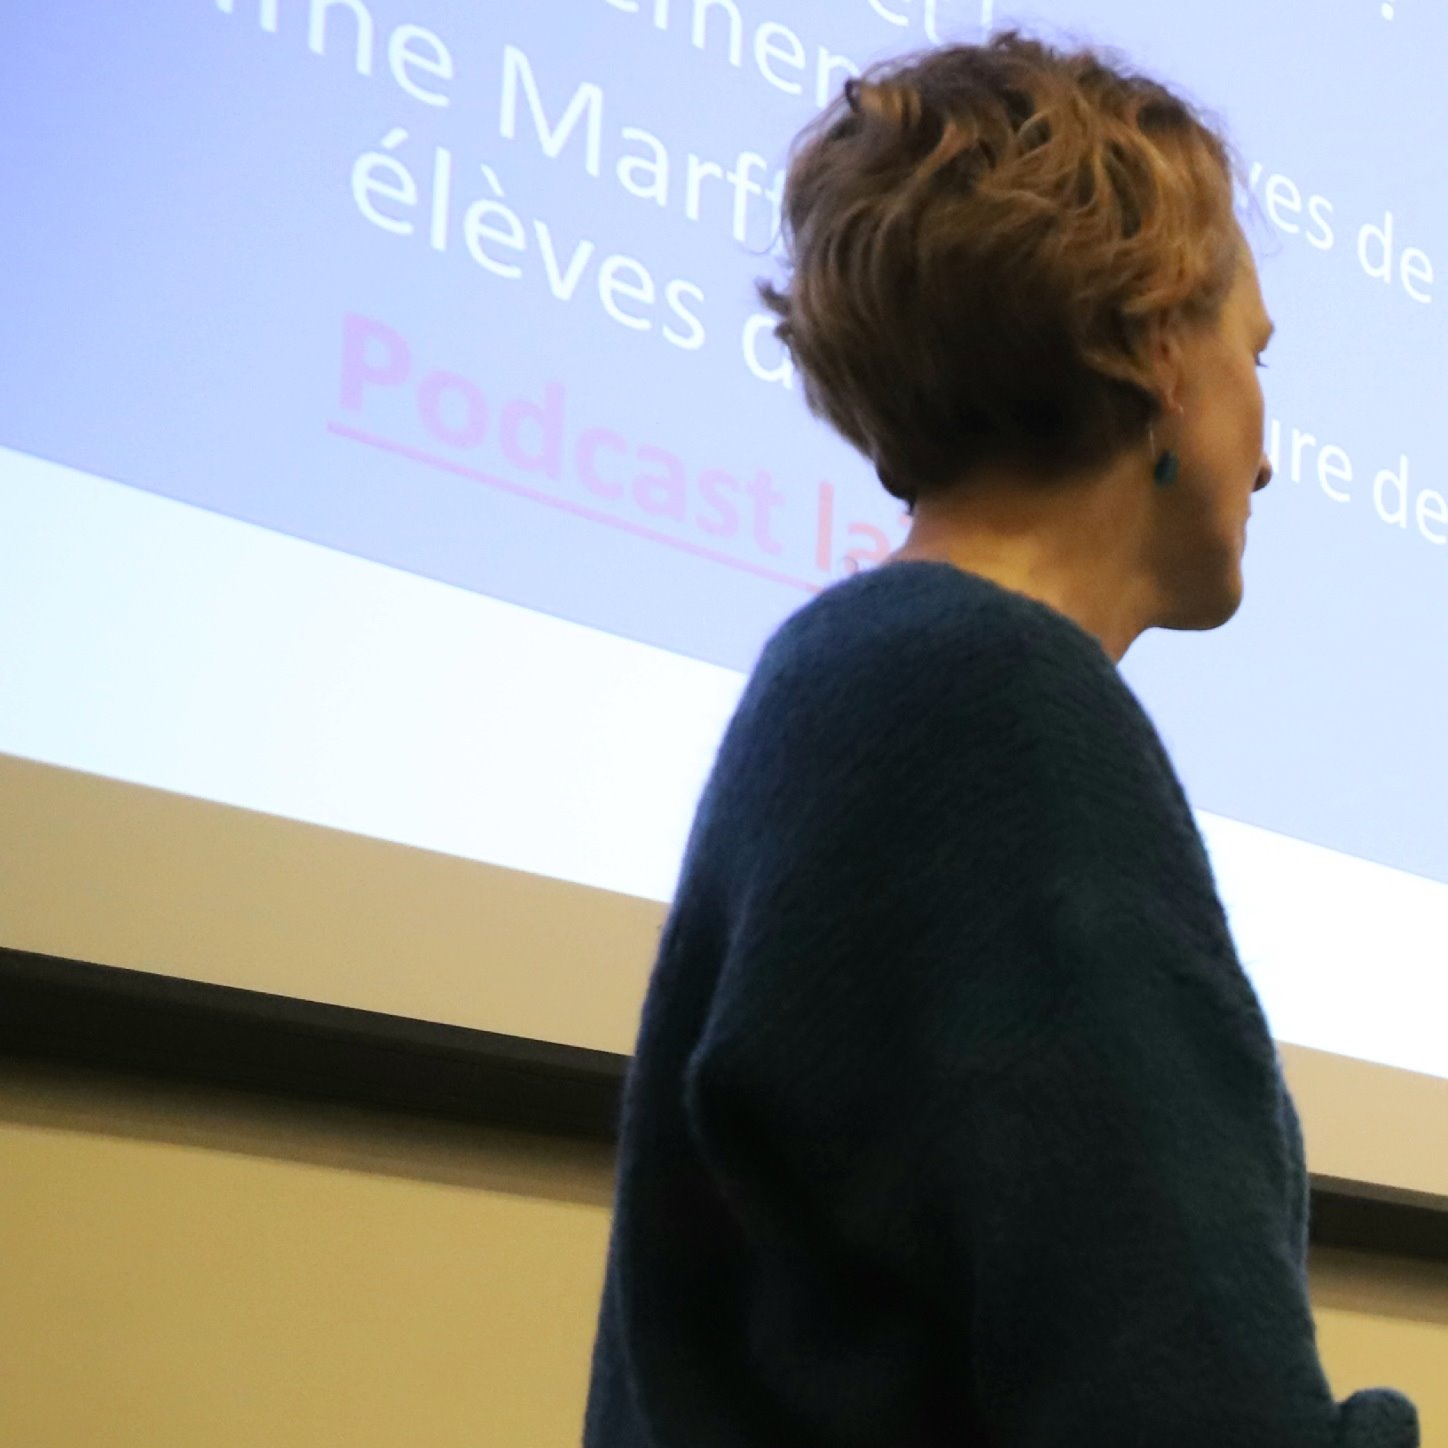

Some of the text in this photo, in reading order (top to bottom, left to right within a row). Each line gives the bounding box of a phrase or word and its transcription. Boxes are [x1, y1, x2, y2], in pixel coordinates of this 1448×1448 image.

[351, 127, 706, 351] élèves
[1357, 210, 1434, 304] de
[339, 311, 786, 556] Podcast
